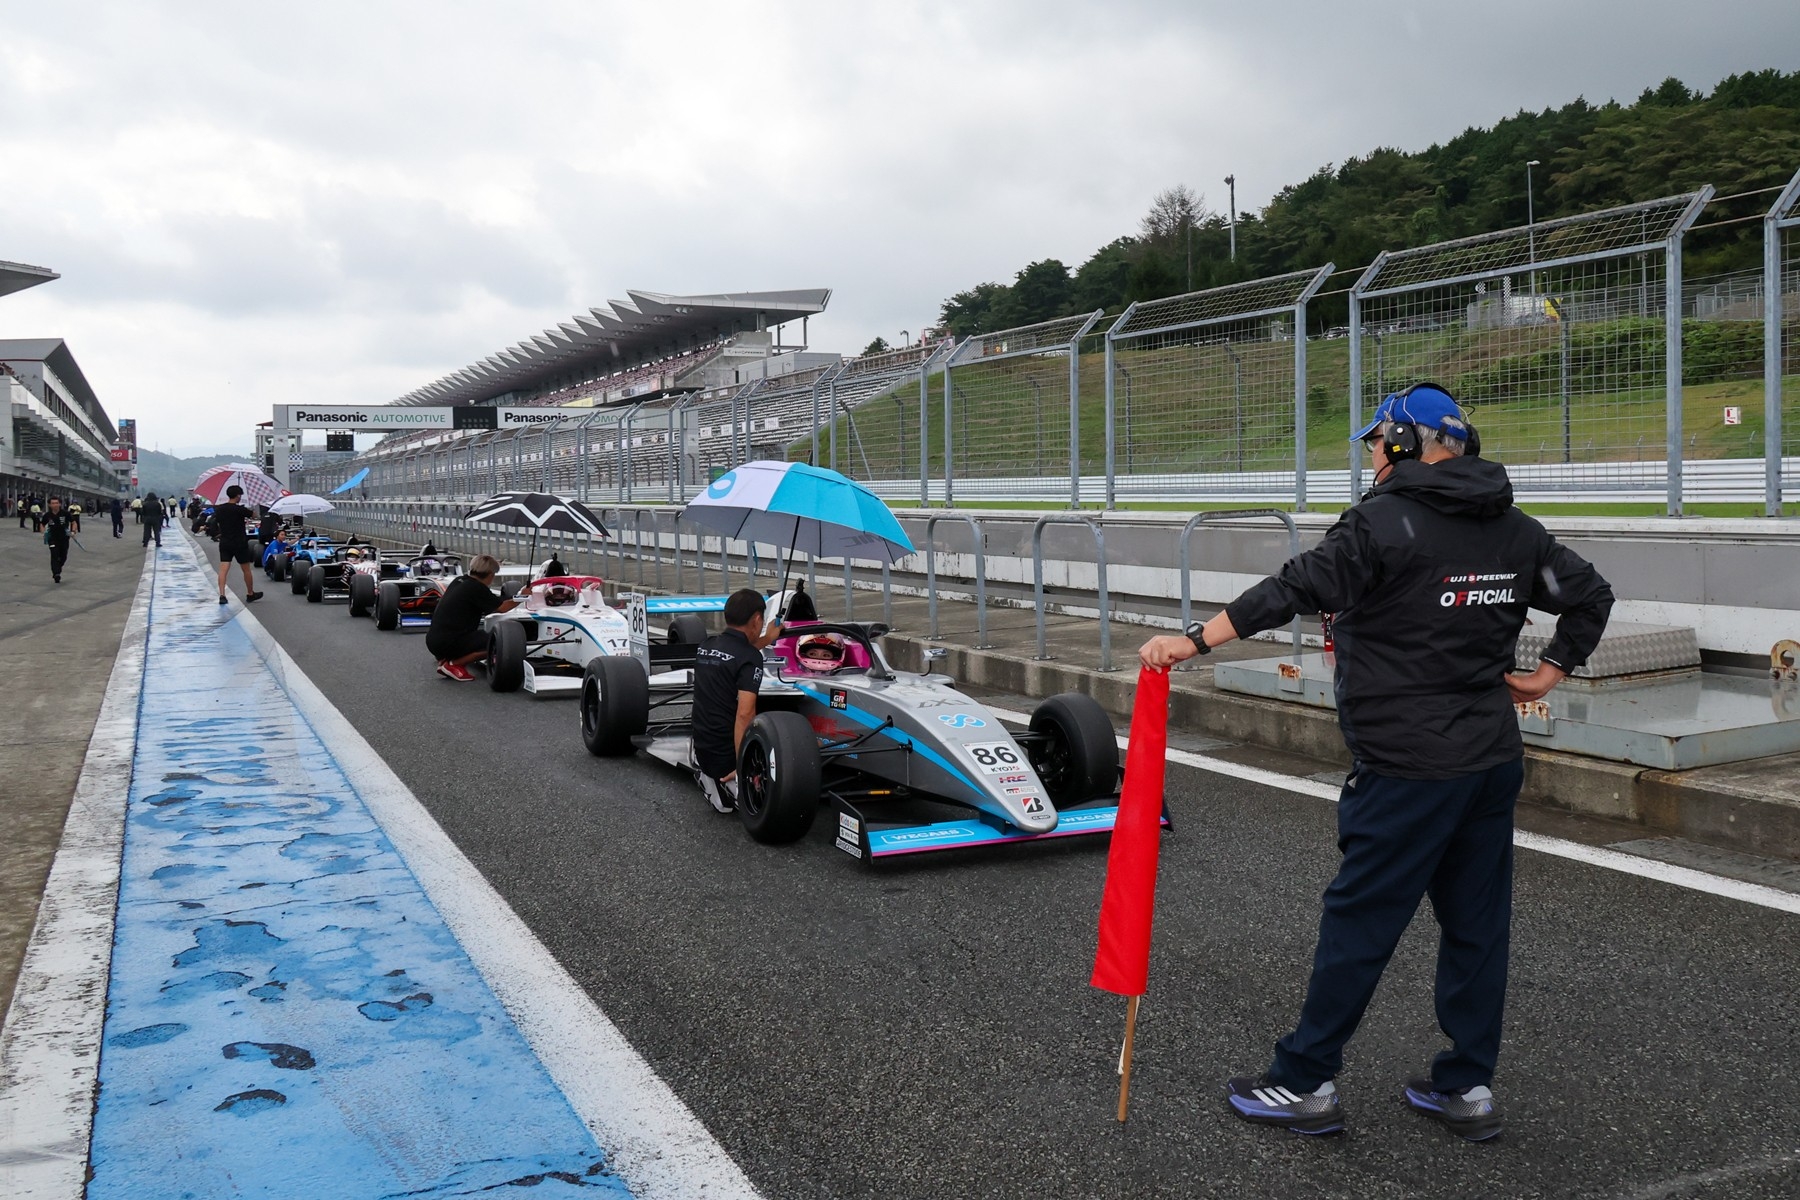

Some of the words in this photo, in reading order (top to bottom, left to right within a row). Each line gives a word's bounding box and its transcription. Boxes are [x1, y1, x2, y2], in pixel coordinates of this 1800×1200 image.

[296, 411, 368, 423] Panasonic
[373, 414, 446, 423] AUTOMOTIVE
[1443, 575, 1467, 583] FUJI
[1468, 573, 1518, 582] SPEEDWAY
[1440, 588, 1516, 607] OFFICIAL
[632, 606, 644, 634] 86
[607, 638, 628, 648] 17
[833, 695, 845, 704] GR
[972, 746, 1019, 766] 86
[893, 829, 960, 840] WECARS
